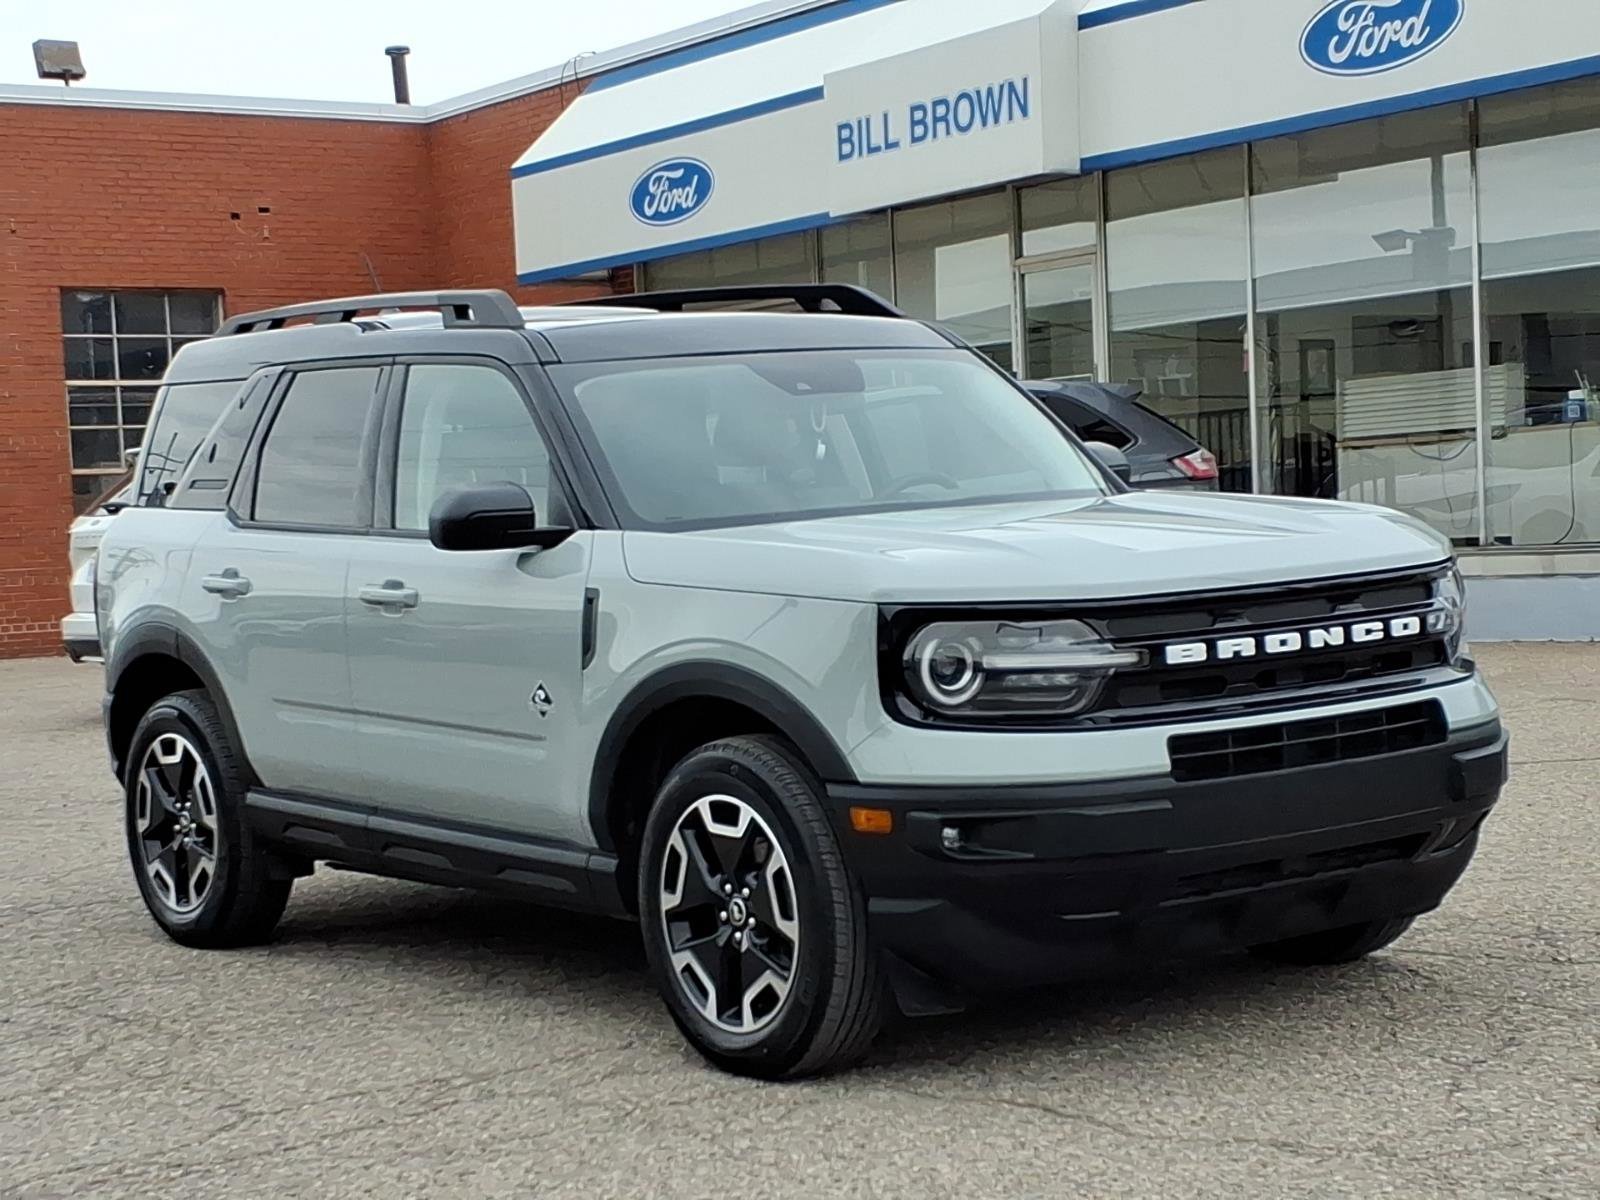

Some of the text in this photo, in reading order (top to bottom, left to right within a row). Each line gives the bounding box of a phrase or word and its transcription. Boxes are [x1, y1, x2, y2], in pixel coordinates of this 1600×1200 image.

[1328, 0, 1432, 63] Ford
[836, 76, 1030, 162] BILL BROWN
[643, 168, 699, 217] Ford
[1165, 616, 1421, 665] BRONCO
